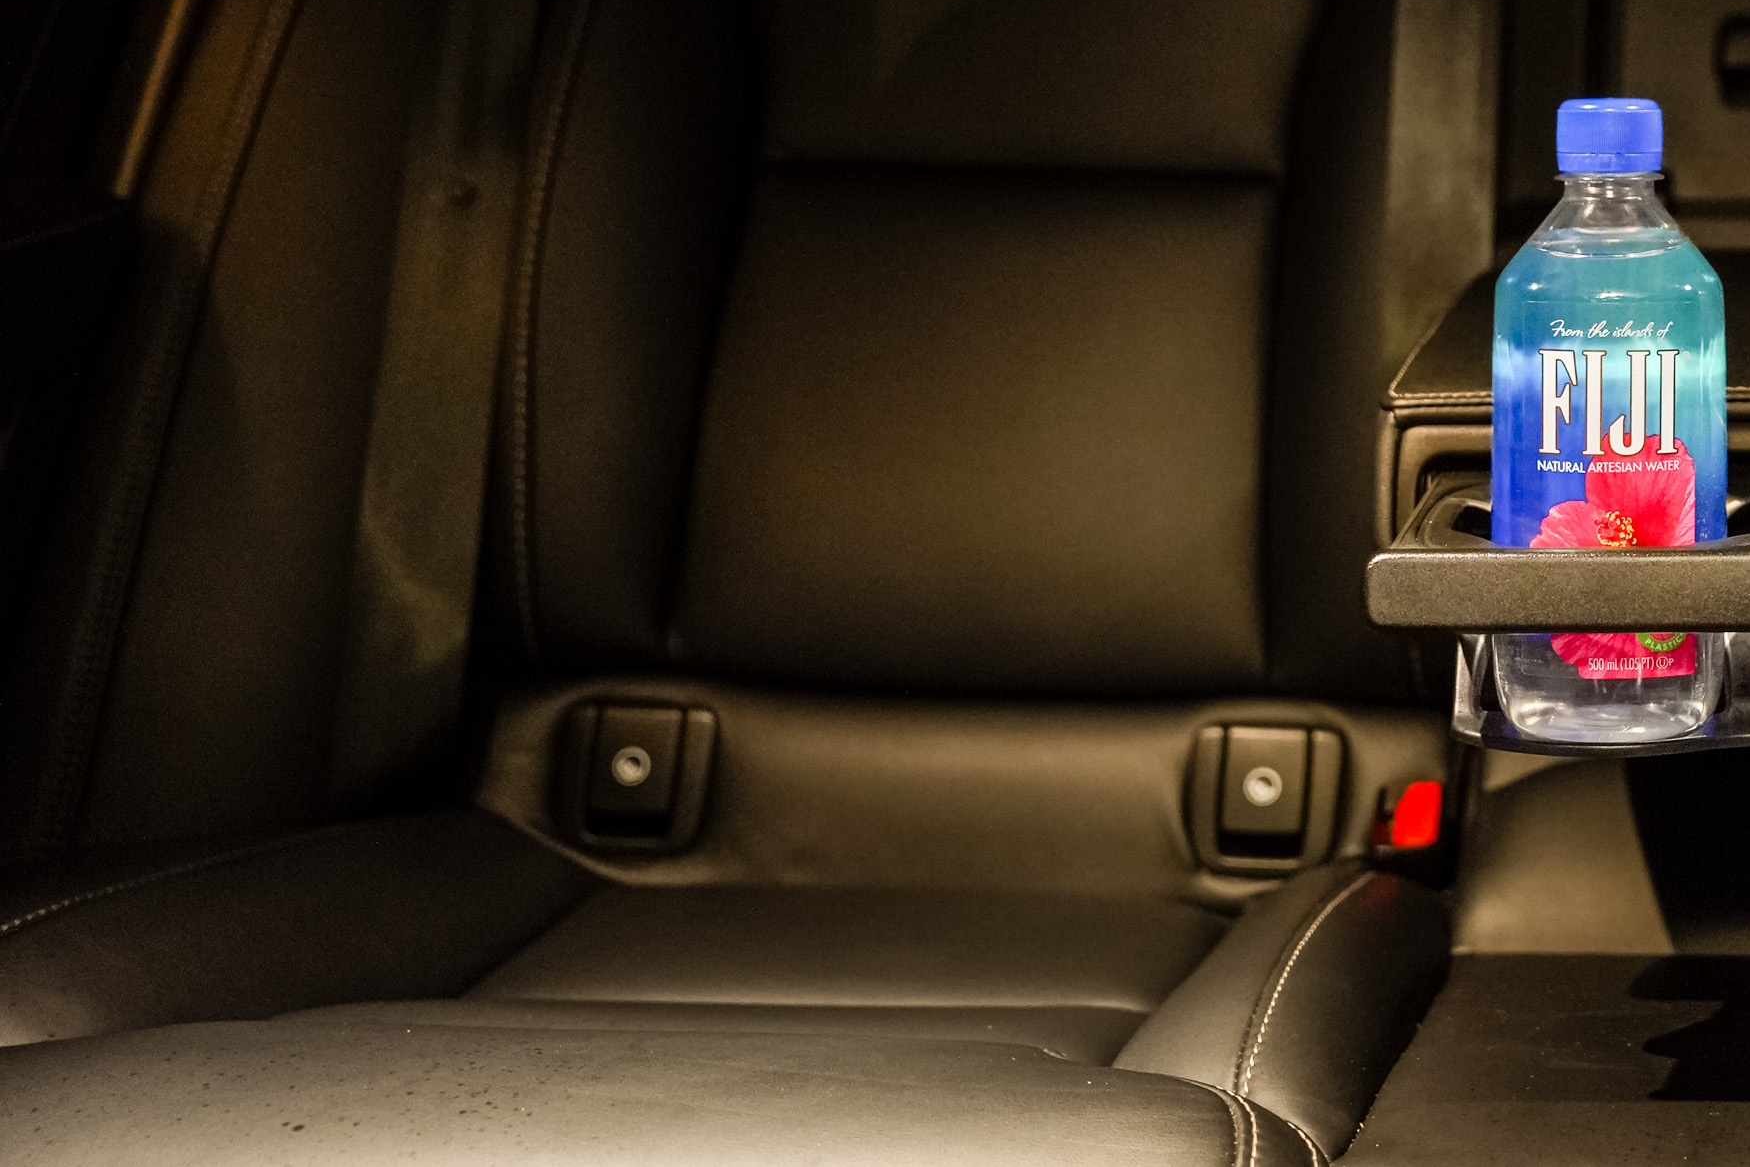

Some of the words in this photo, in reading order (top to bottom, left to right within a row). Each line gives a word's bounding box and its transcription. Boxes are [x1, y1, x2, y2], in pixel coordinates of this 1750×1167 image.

[1550, 319, 1584, 337] From
[1587, 320, 1610, 338] the
[1613, 320, 1654, 338] islands
[1656, 321, 1674, 341] of
[1538, 349, 1680, 456] FIJI
[1537, 459, 1586, 473] NATURAL
[1587, 460, 1642, 473] ARTESIAN
[1644, 459, 1680, 471] WATER
[1588, 657, 1605, 671] 500
[1607, 657, 1619, 671] mL
[1641, 656, 1655, 670] PT)
